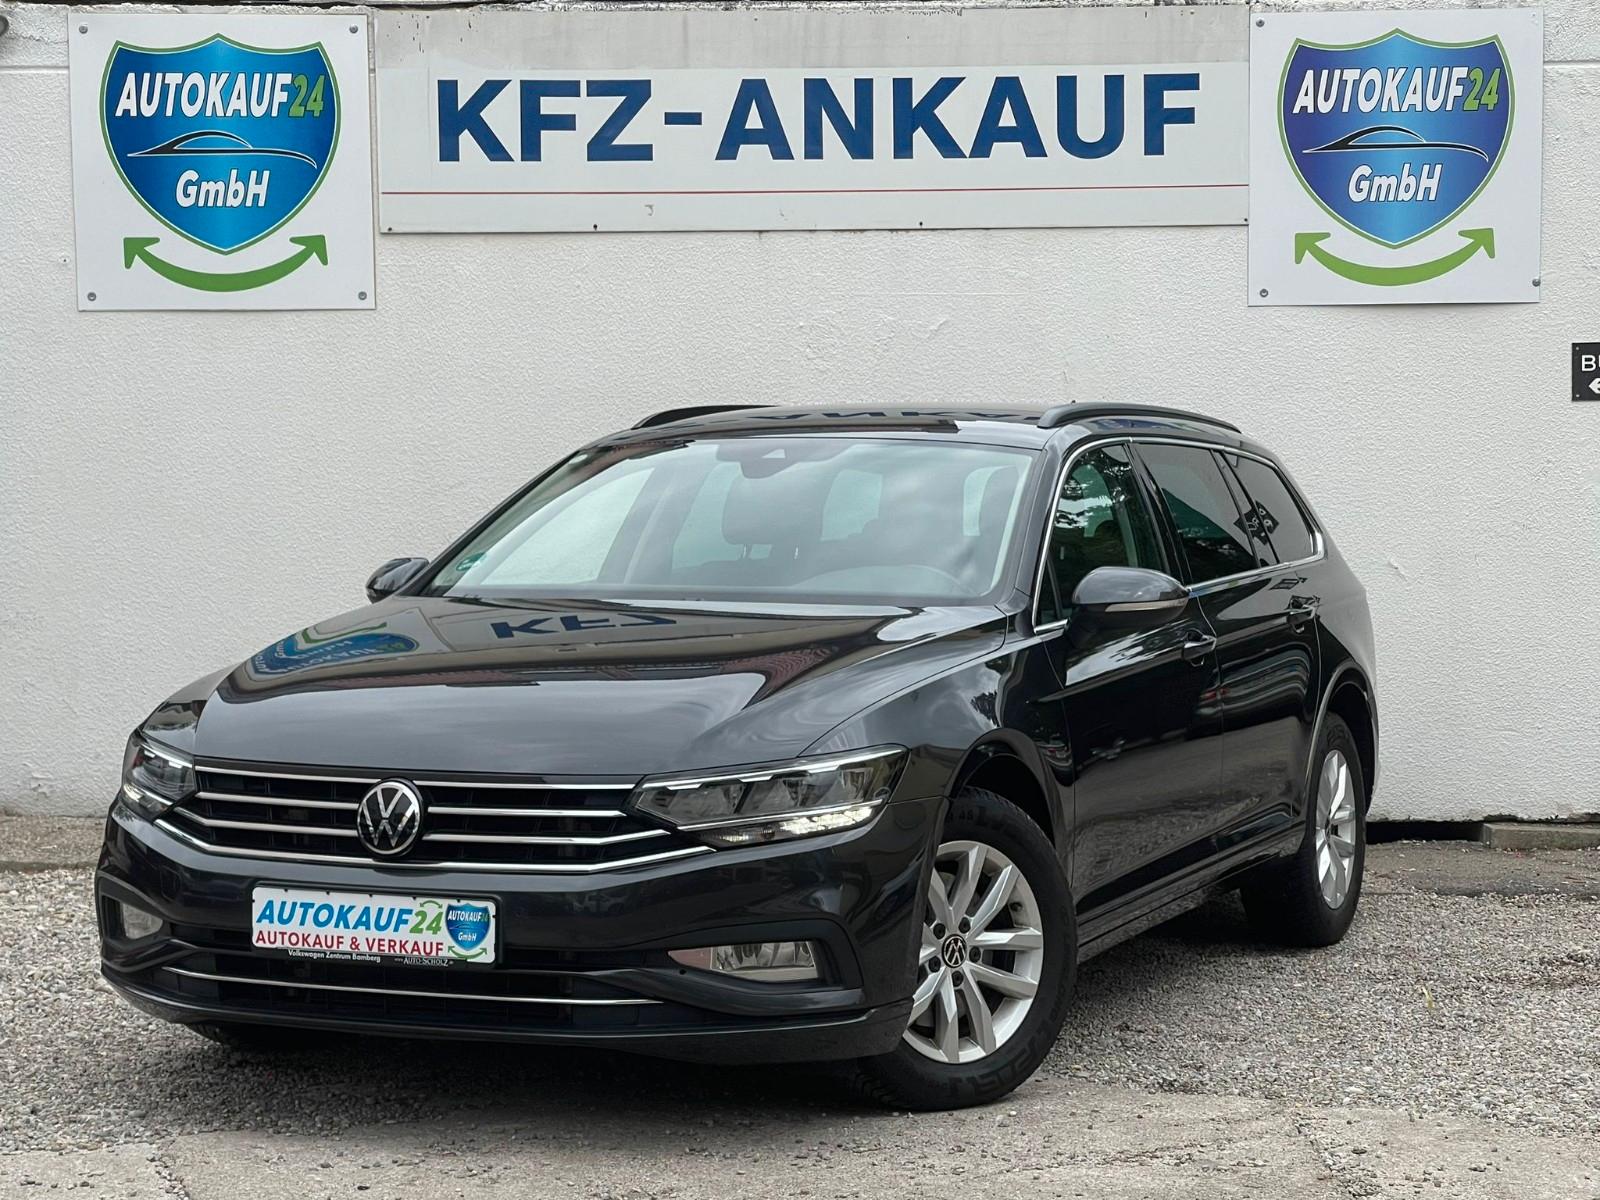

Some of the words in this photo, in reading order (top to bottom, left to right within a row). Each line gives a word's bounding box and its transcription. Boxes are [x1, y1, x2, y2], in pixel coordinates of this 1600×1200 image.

[115, 72, 325, 117] AUTOKAUF24
[1291, 66, 1501, 114] AUTOKAUF24
[437, 73, 1200, 162] KFZ-ANKAUF
[175, 168, 270, 208] GmbH
[1348, 163, 1443, 202] GmbH
[1581, 354, 1600, 372] B
[256, 900, 443, 935] AUTOKAUF24
[256, 930, 344, 951] AUTOKAUF
[349, 936, 361, 951] &
[365, 938, 444, 957] VERKAUF
[288, 948, 325, 959] Volkswagen
[325, 950, 351, 960] Zentrum
[352, 952, 381, 963] Bamberg
